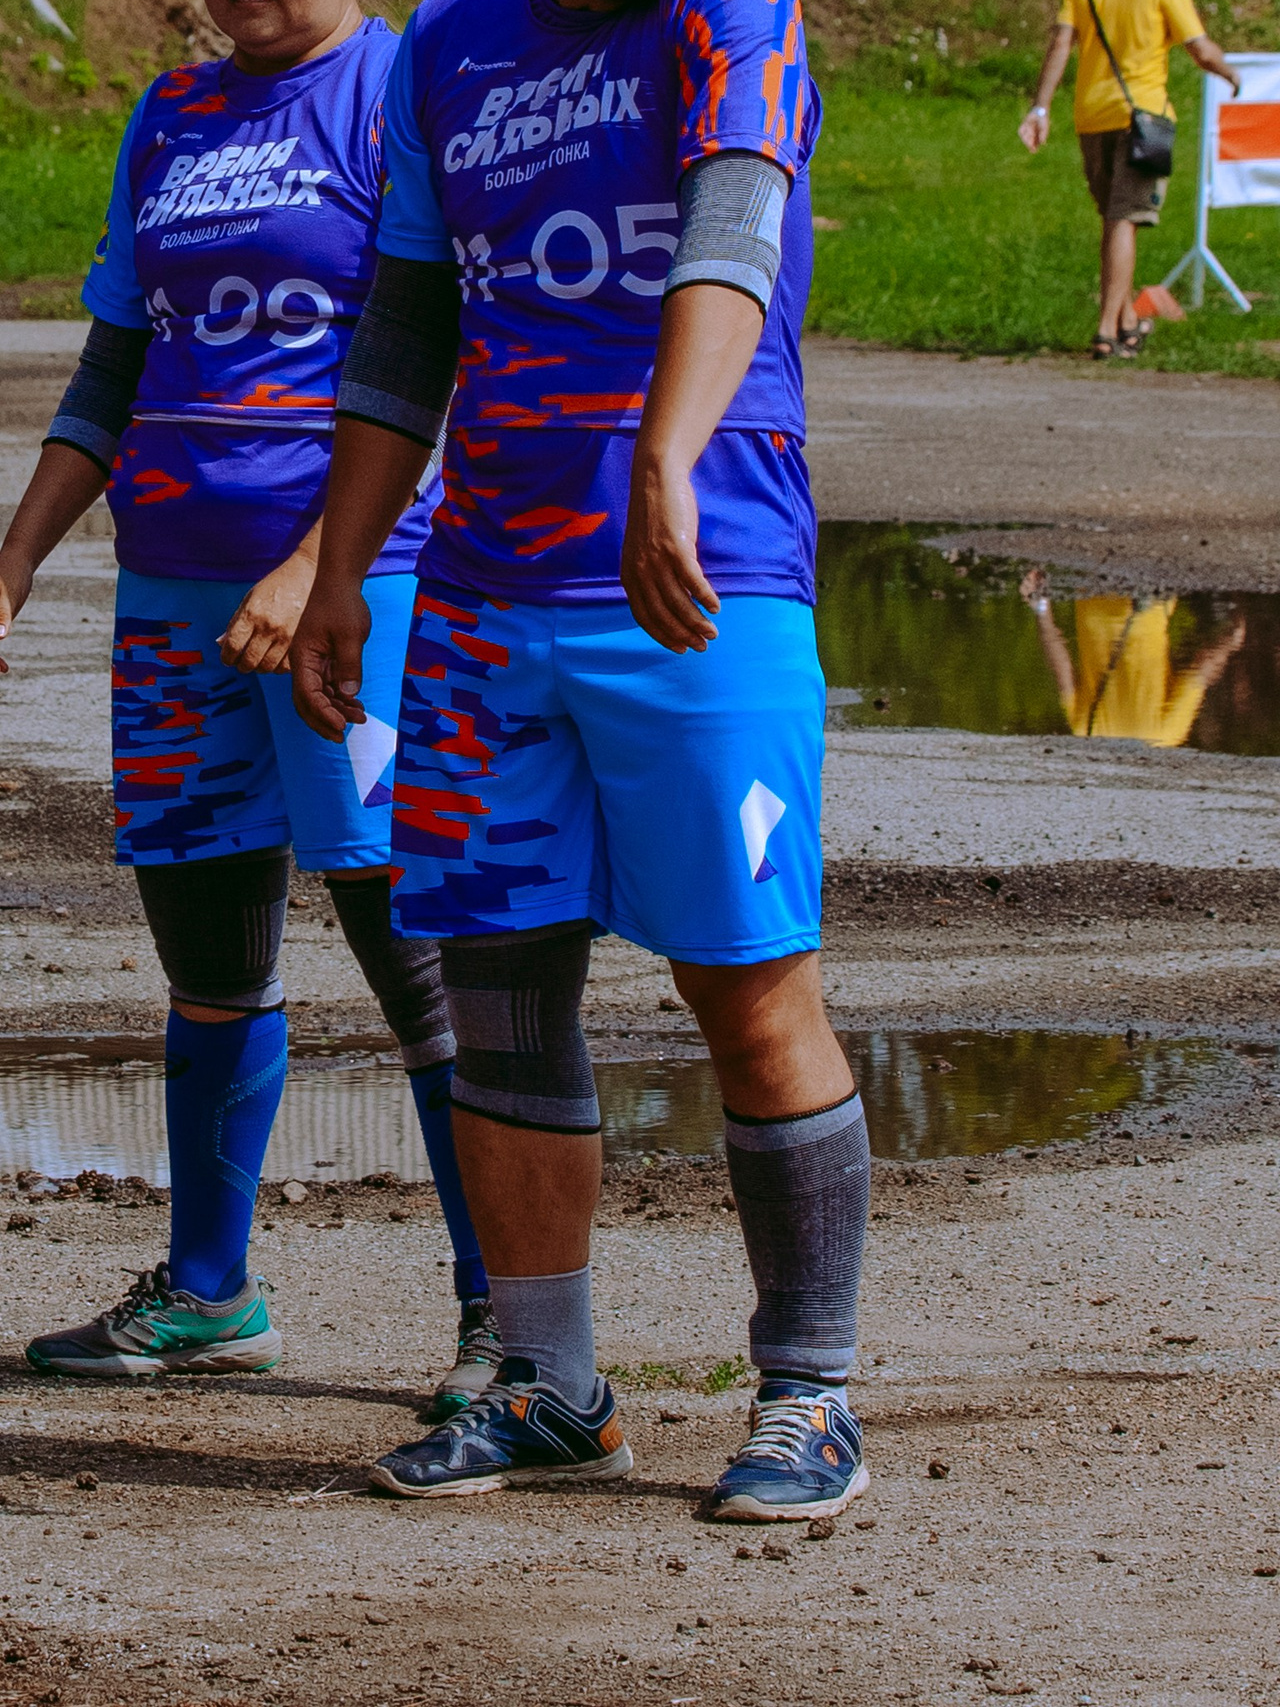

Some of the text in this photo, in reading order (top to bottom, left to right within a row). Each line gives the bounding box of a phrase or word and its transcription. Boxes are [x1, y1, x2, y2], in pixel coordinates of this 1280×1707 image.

[159, 136, 300, 191] ВРЕМЯ
[548, 140, 590, 169] ГОНКА
[136, 170, 331, 233] СИЛЬНЫХ
[160, 217, 260, 250] БОЛЬШАЯ ГОНКА
